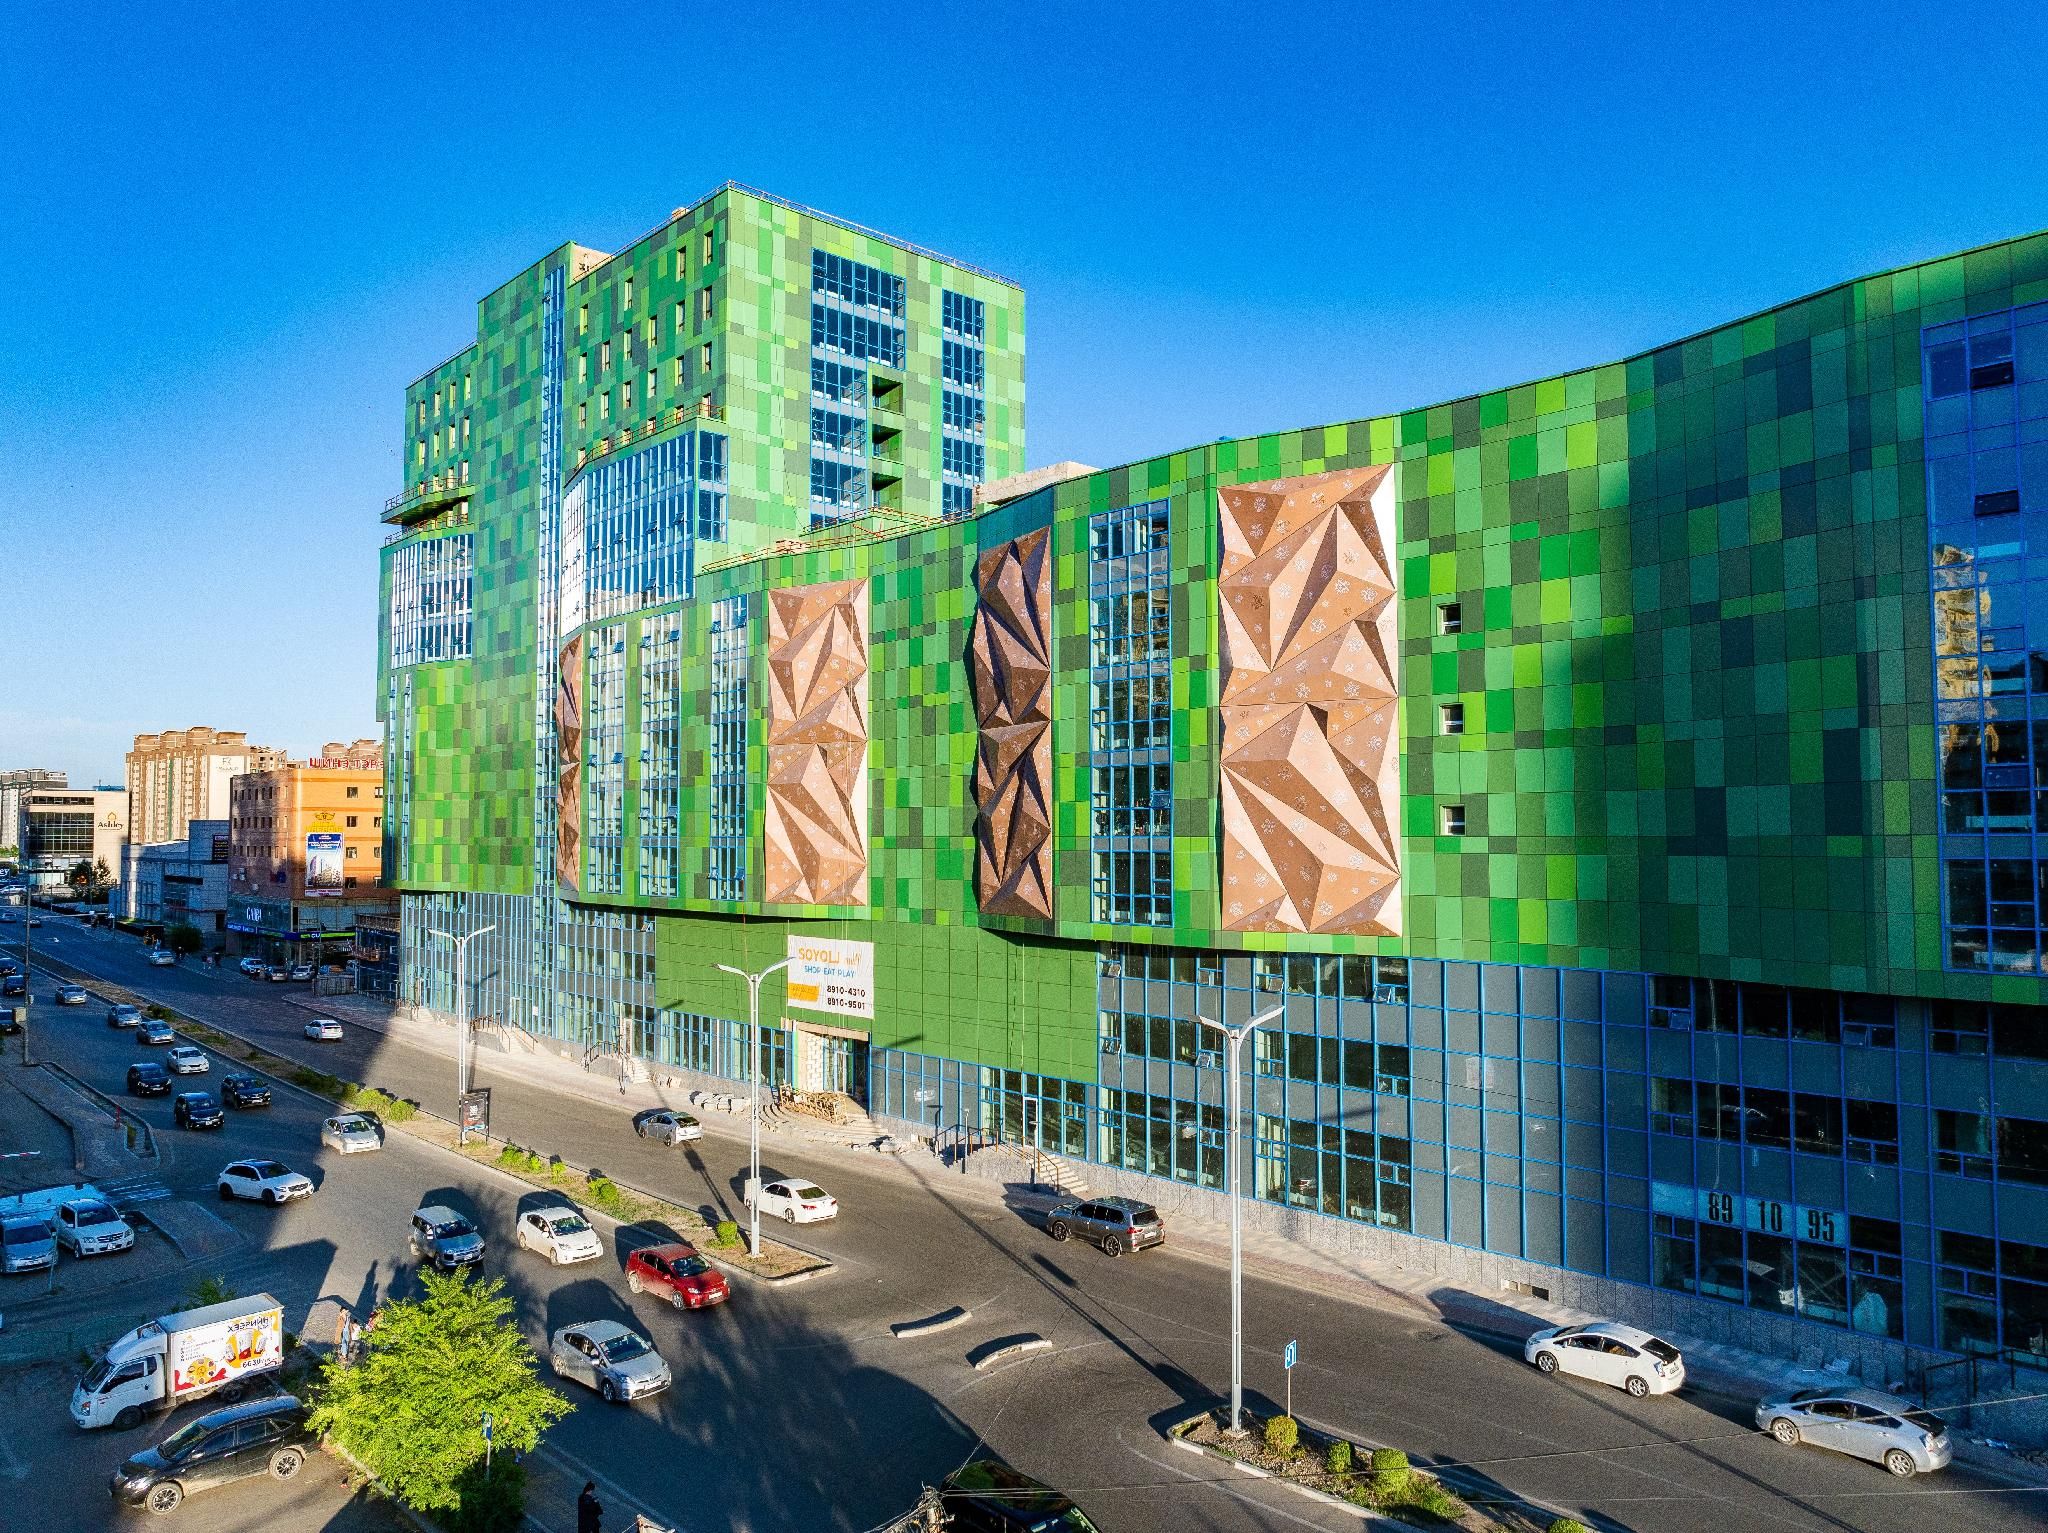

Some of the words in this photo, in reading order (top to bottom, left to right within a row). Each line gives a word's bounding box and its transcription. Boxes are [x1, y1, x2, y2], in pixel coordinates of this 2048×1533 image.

[309, 757, 349, 768] ШИНЭ
[804, 965, 821, 974] SHOP
[823, 967, 836, 976] EAT
[837, 969, 855, 978] PLAY
[826, 985, 866, 997] 8910-4310
[827, 997, 865, 1010] 8910-9501
[1708, 1191, 1733, 1224] 89
[1758, 1200, 1783, 1232] 10
[1808, 1210, 1835, 1242] 95
